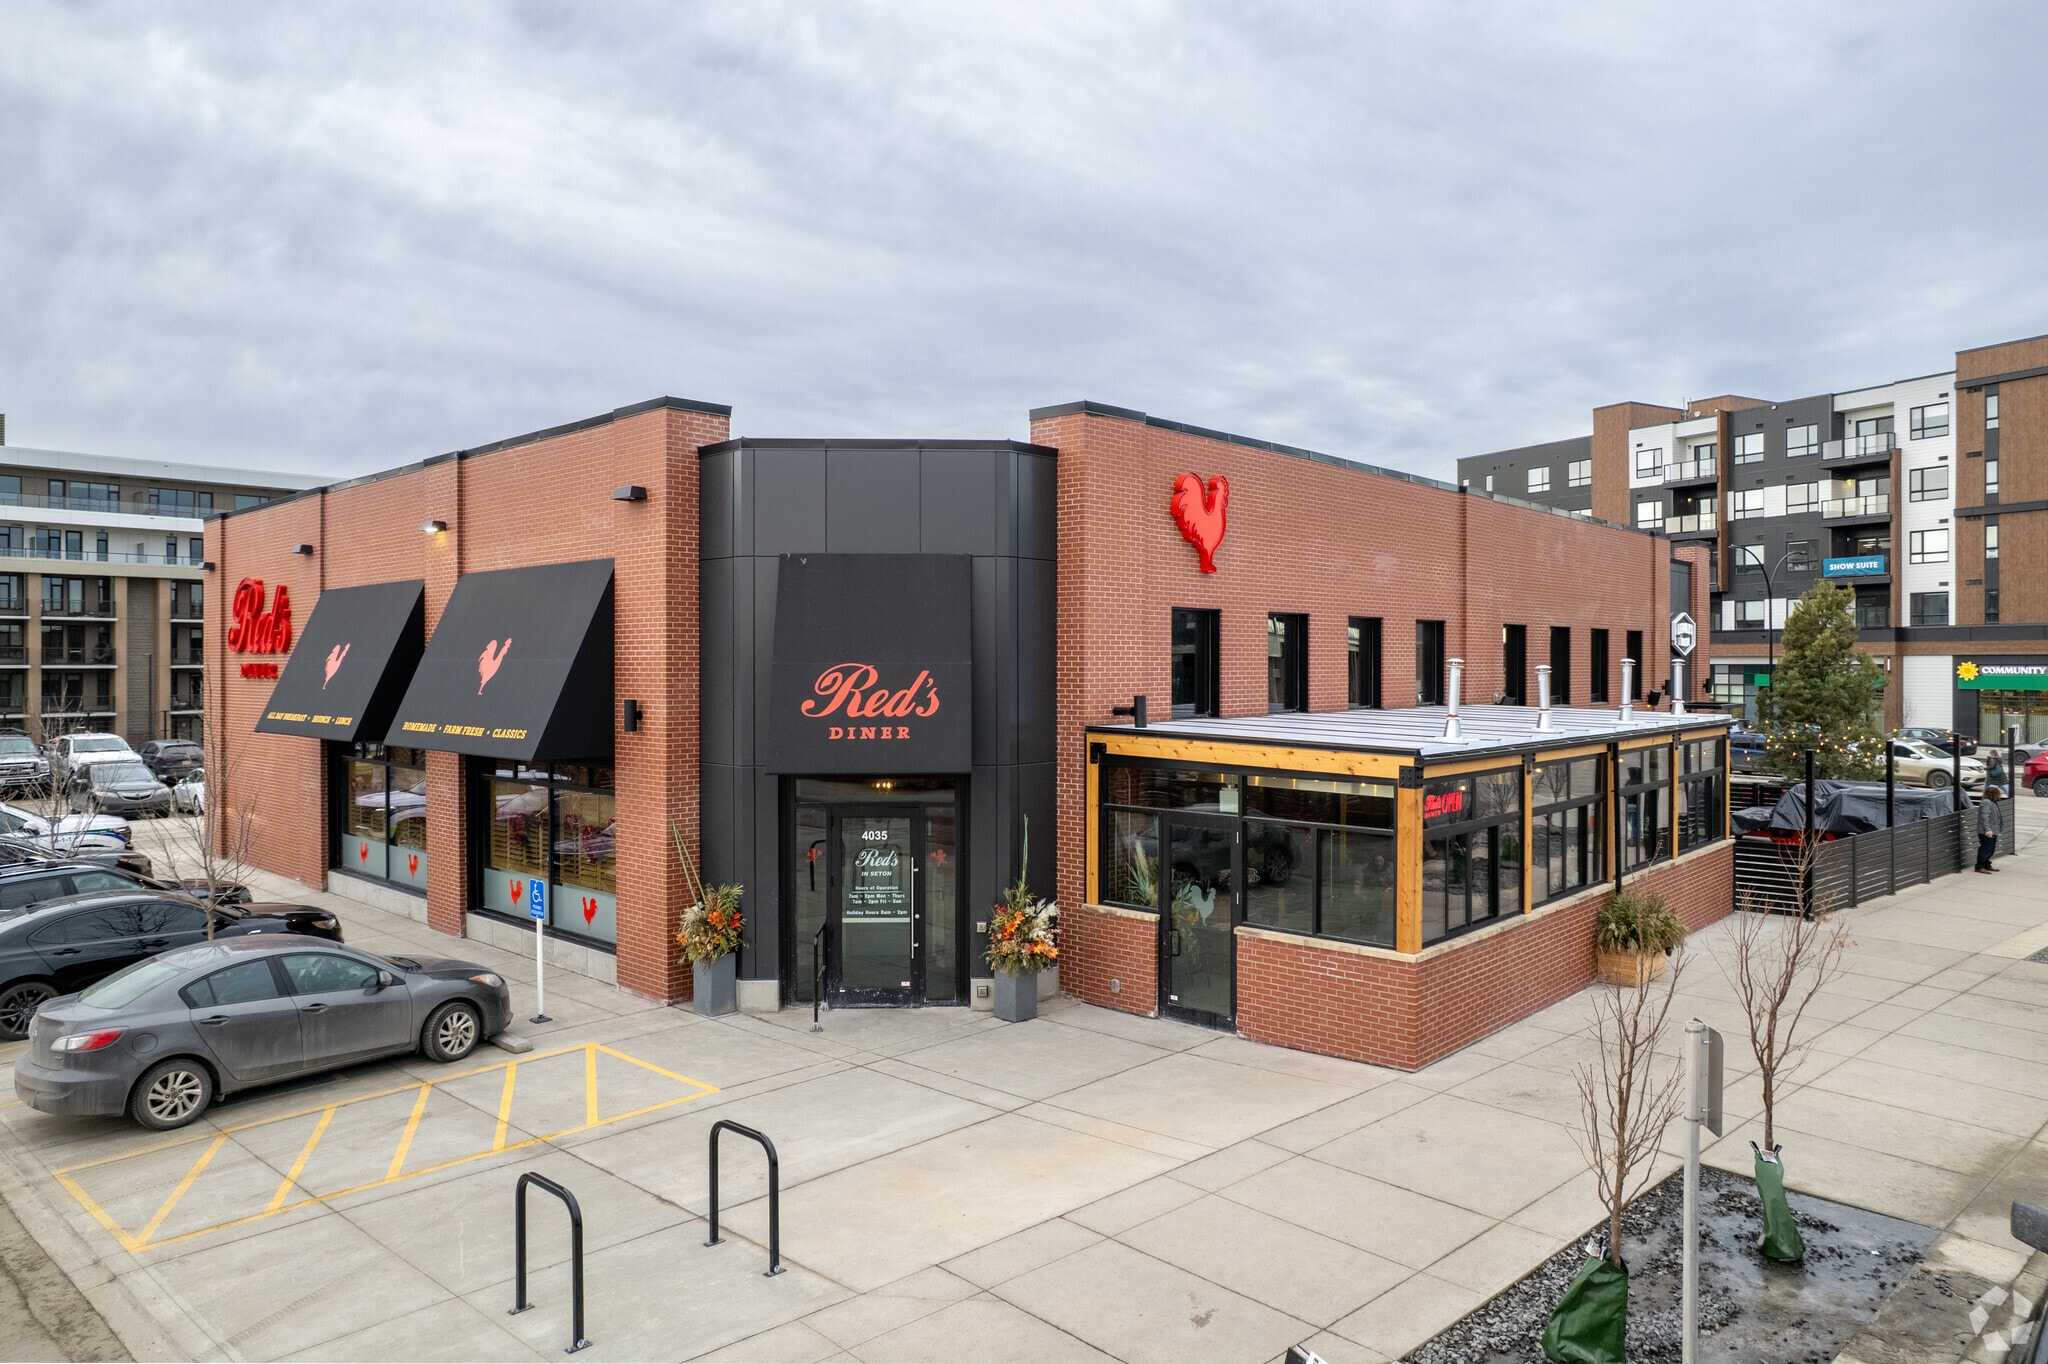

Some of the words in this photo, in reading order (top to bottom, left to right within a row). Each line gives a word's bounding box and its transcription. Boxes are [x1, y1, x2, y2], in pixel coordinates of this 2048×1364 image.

[1829, 562, 1854, 571] SHOW
[1855, 561, 1878, 569] SUITE
[1981, 666, 2047, 675] COMMUNITY
[800, 662, 940, 718] Red's
[401, 721, 438, 733] HOMEMADE
[443, 724, 463, 735] FARM
[461, 725, 485, 737] FRESH
[492, 728, 528, 740] CLASSICS
[828, 726, 910, 740] DINER
[1441, 791, 1463, 813] OPEN
[861, 830, 888, 841] 4035
[855, 848, 899, 867] Red's
